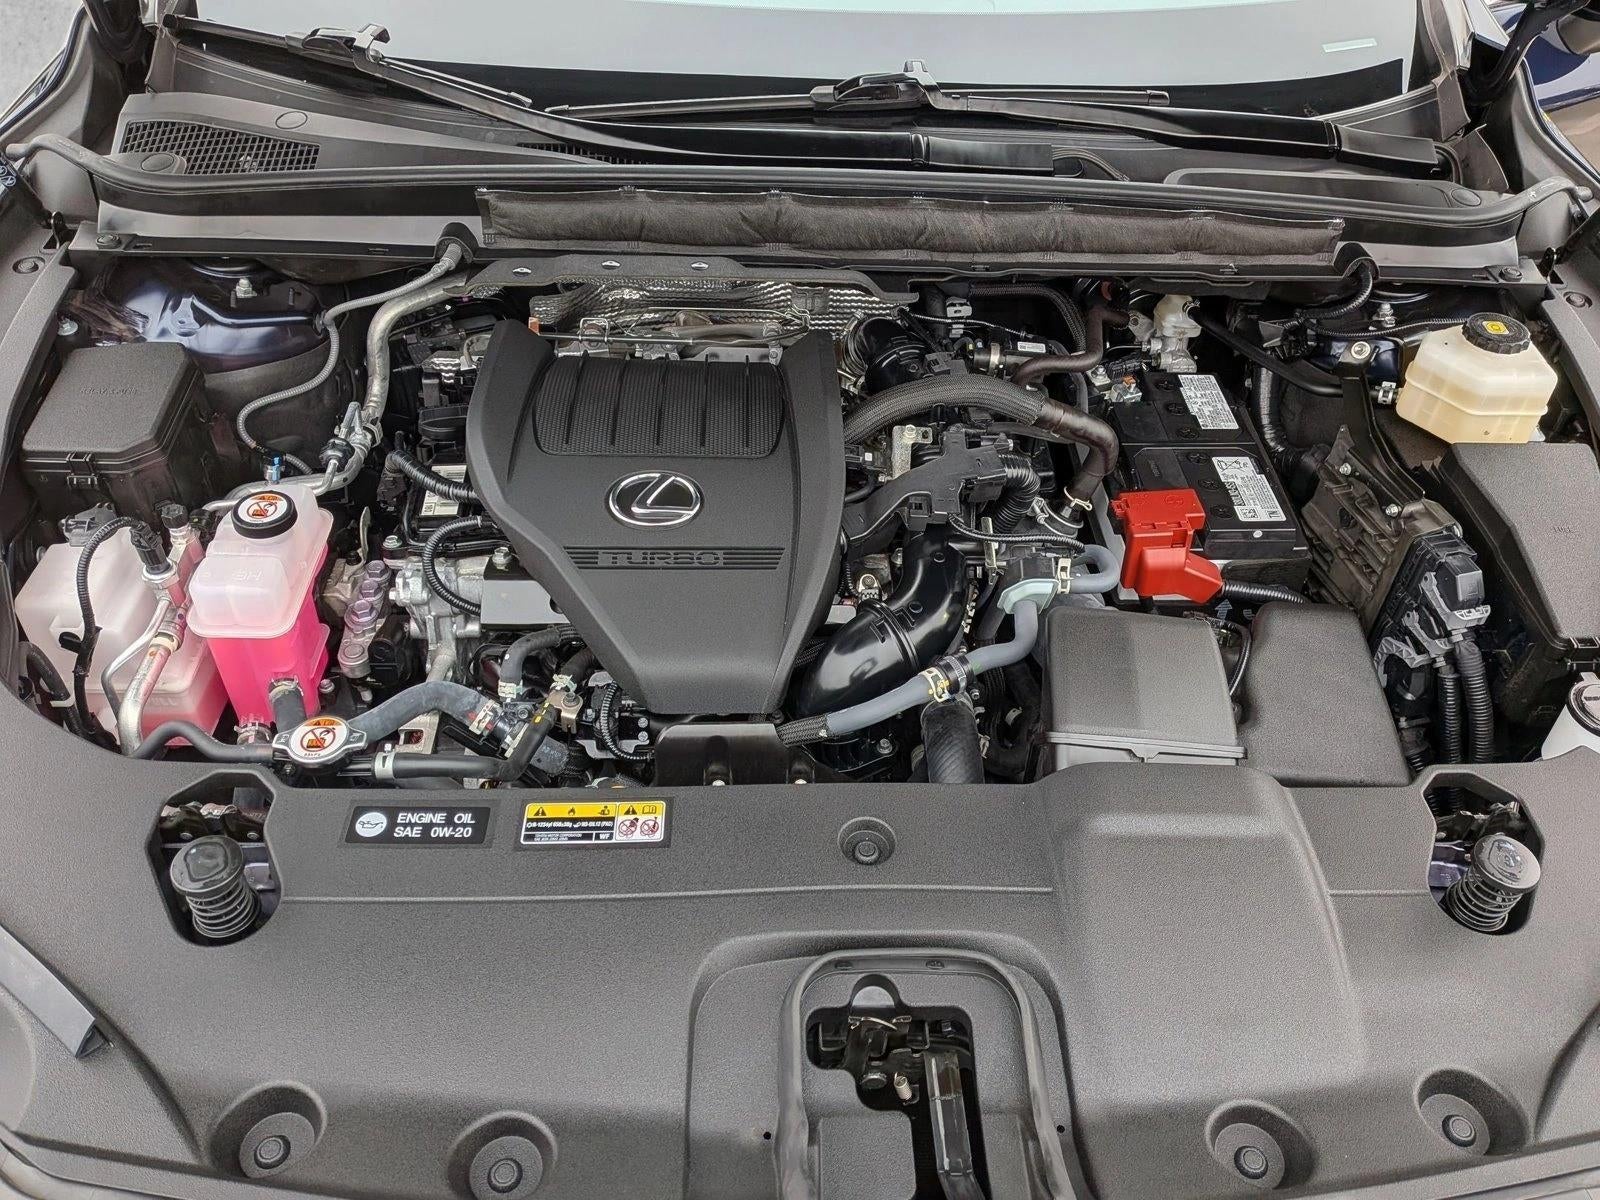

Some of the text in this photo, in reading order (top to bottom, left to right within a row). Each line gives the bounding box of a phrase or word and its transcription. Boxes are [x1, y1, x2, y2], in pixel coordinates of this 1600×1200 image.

[601, 550, 720, 567] TURBO
[396, 812, 476, 824] ENGINE OIL
[393, 826, 473, 838] SAE 0W-20
